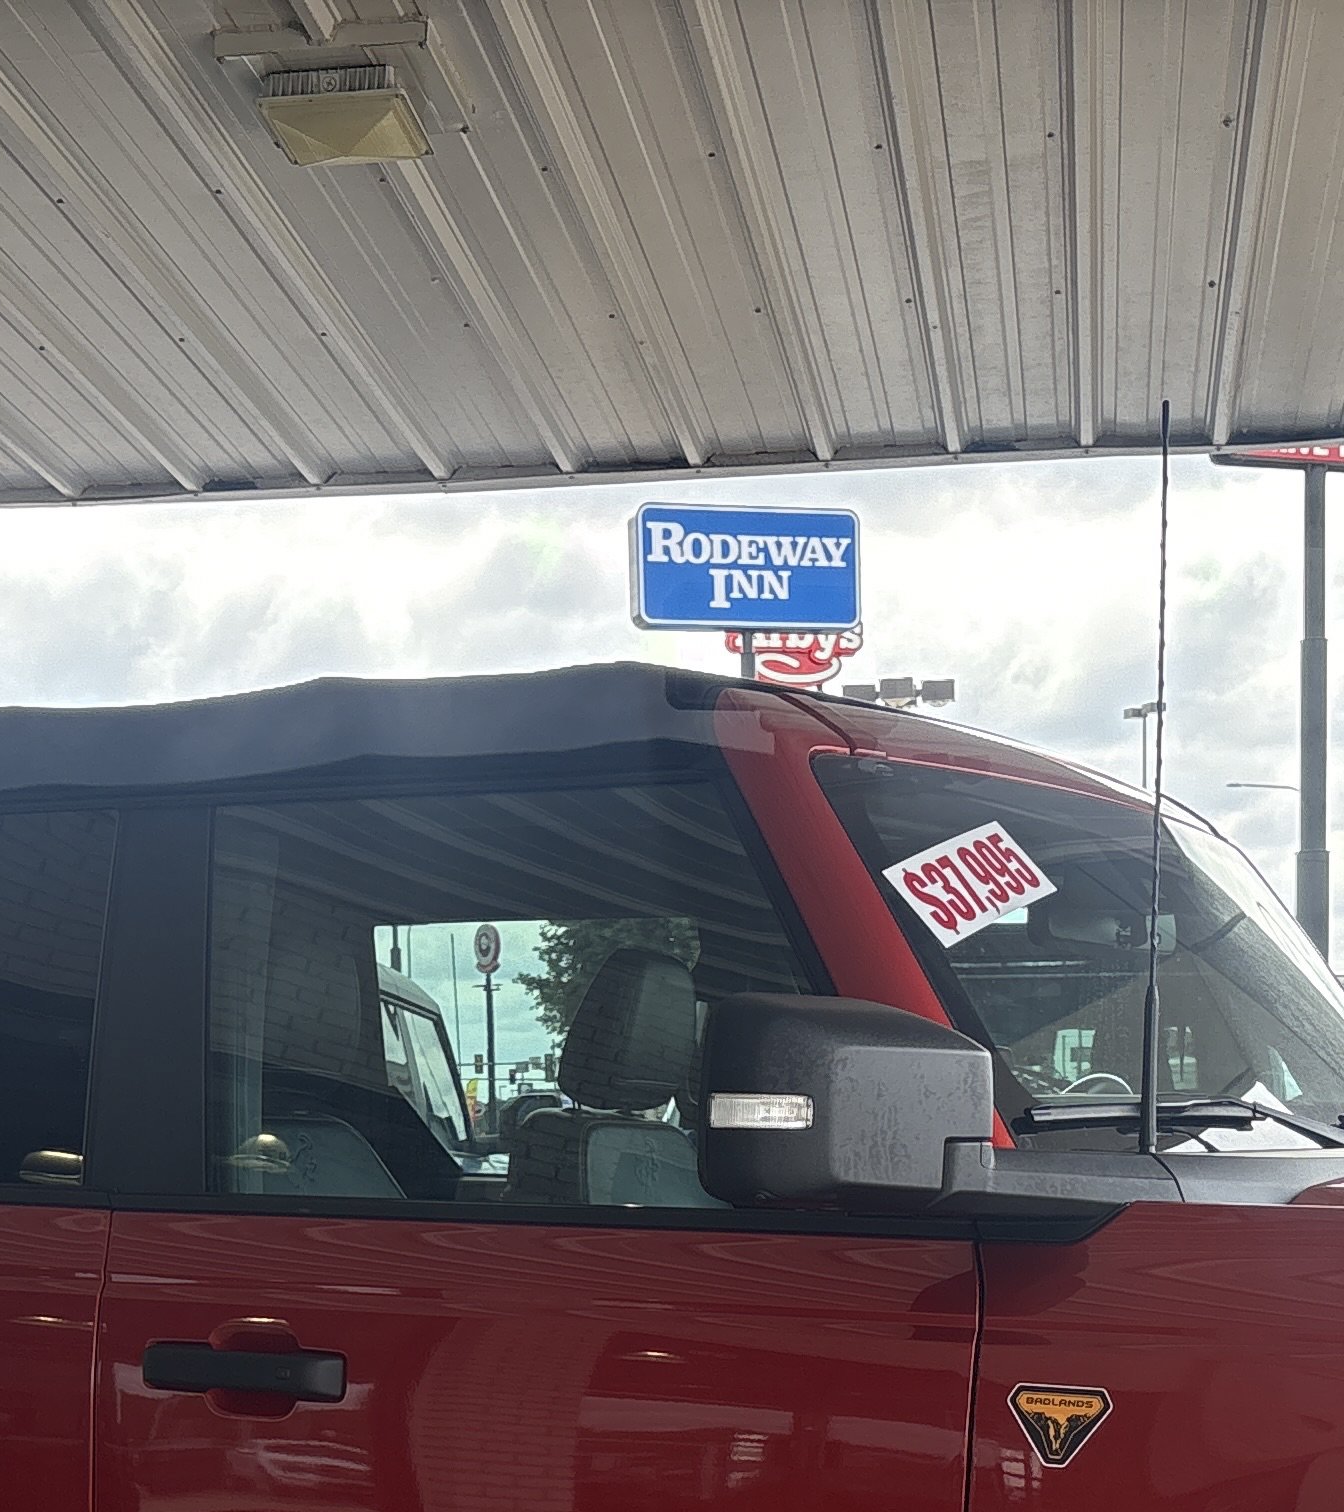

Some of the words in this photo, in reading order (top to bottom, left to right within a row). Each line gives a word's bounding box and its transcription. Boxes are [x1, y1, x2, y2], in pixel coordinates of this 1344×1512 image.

[645, 520, 852, 568] RODEWAY
[708, 568, 792, 609] INN
[902, 832, 1041, 936] $37,995
[1025, 1395, 1094, 1409] BADLANDS
